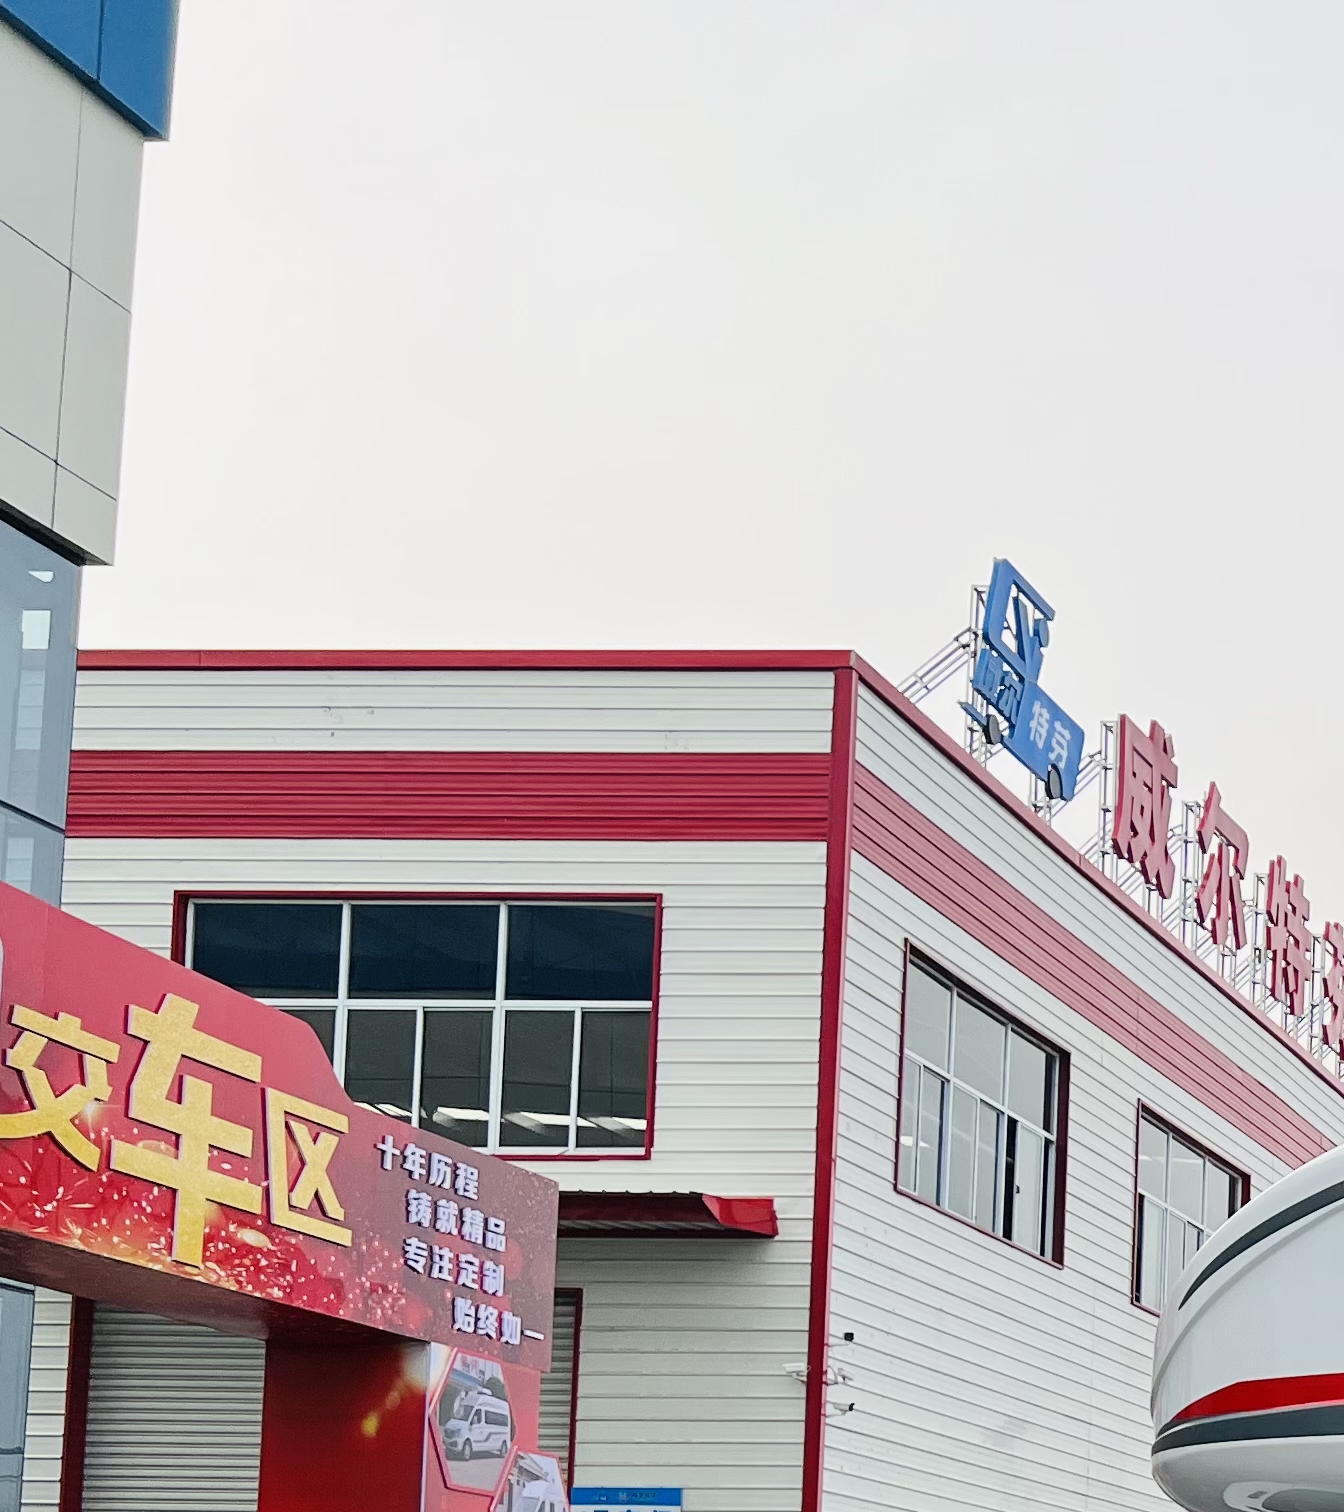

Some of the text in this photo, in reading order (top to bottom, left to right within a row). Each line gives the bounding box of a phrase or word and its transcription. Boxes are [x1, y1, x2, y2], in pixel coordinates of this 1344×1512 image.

[0, 993, 353, 1269] 交车区
[376, 1135, 479, 1200] 十年历程
[407, 1188, 507, 1252] 铸就精品
[404, 1236, 505, 1297] 专注定制
[453, 1296, 545, 1345] 始终如一
